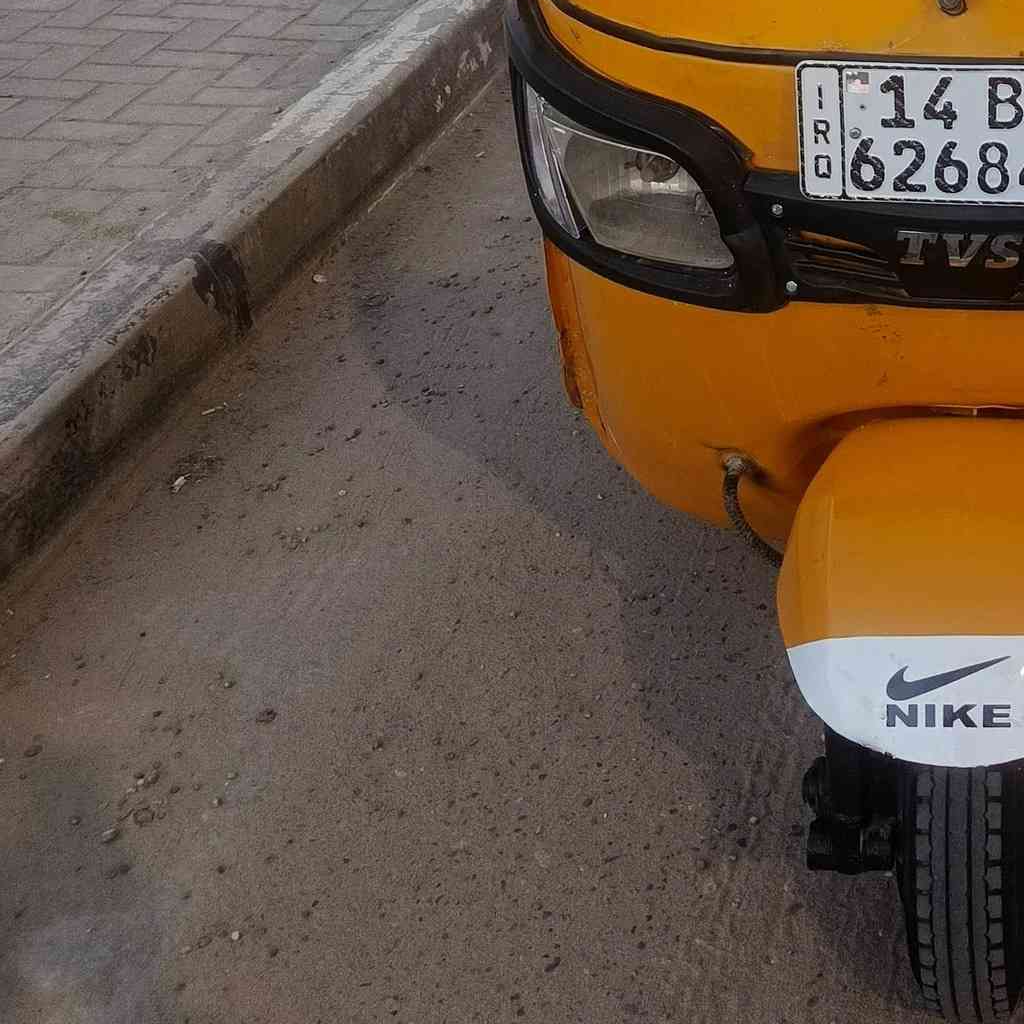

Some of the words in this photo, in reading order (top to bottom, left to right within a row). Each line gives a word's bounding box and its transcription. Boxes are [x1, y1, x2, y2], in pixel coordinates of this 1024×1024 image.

[880, 75, 958, 129] 14
[988, 76, 1024, 129] B
[813, 84, 832, 178] IRQ
[897, 230, 1024, 269] TVS
[885, 703, 1012, 728] NIKE
